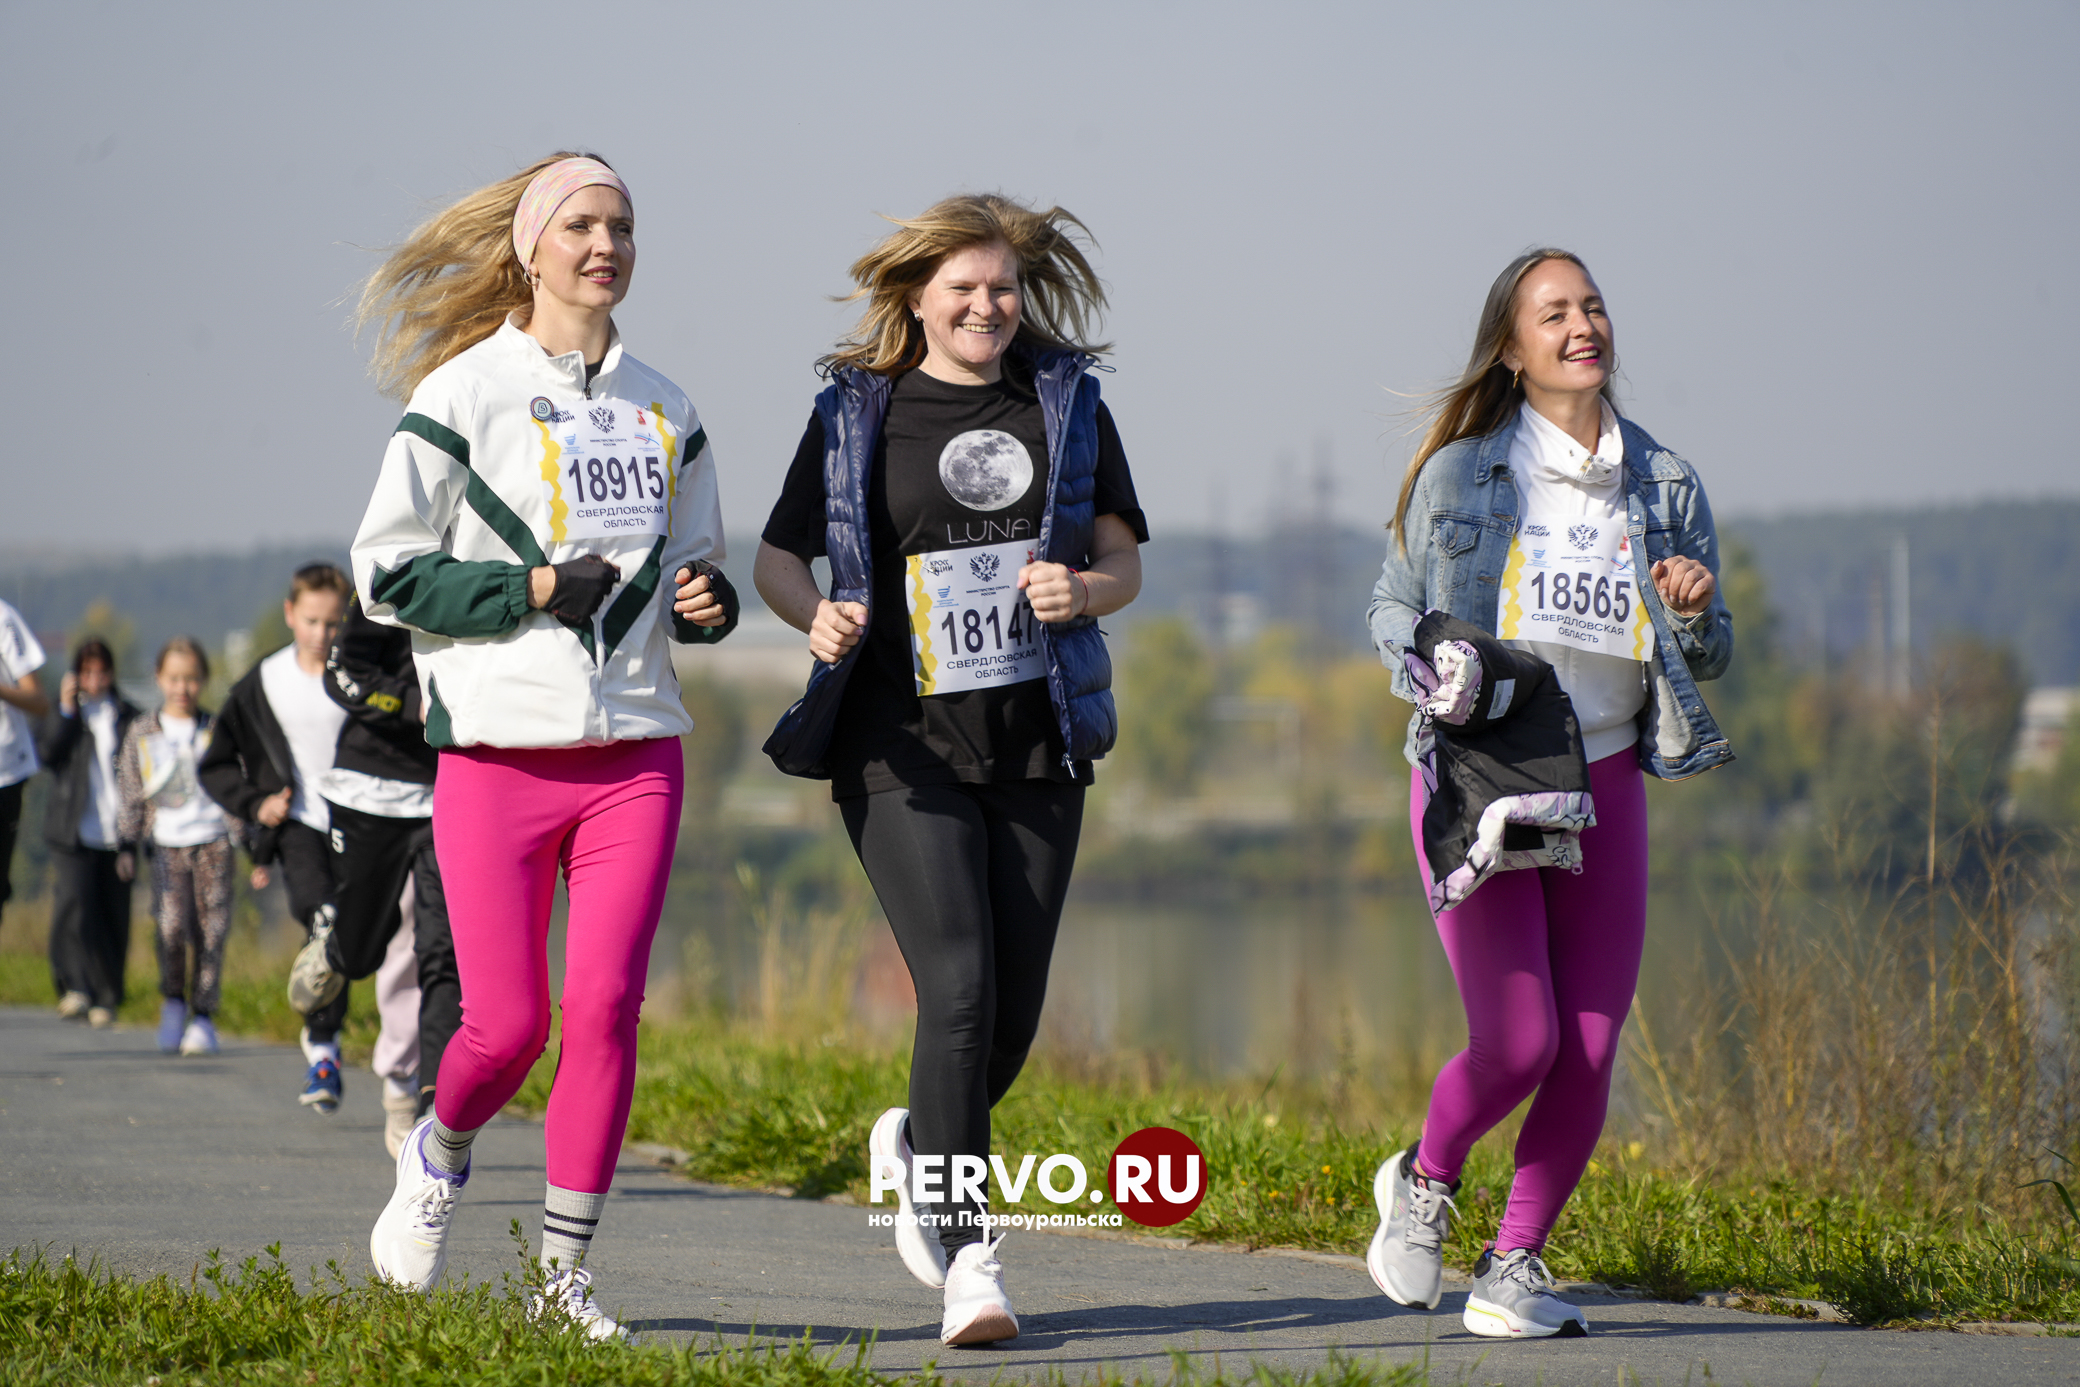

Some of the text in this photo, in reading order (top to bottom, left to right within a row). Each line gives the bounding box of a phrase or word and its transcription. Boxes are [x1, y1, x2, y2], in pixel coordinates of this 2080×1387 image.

[568, 456, 664, 503] 18915
[576, 505, 664, 518] СВЕРДЛОВСКАЯ
[603, 518, 647, 529] ОБЛАСТЬ
[946, 518, 1031, 544] LUNA
[1531, 571, 1631, 623] 18565
[1531, 613, 1625, 637] СВЕРДЛОВСКАЯ
[1558, 626, 1599, 644] ОБЛАСТЬ
[946, 648, 1038, 670] СВЕРДЛОВСКАЯ
[974, 665, 1019, 679] ОБЛАСТЬ
